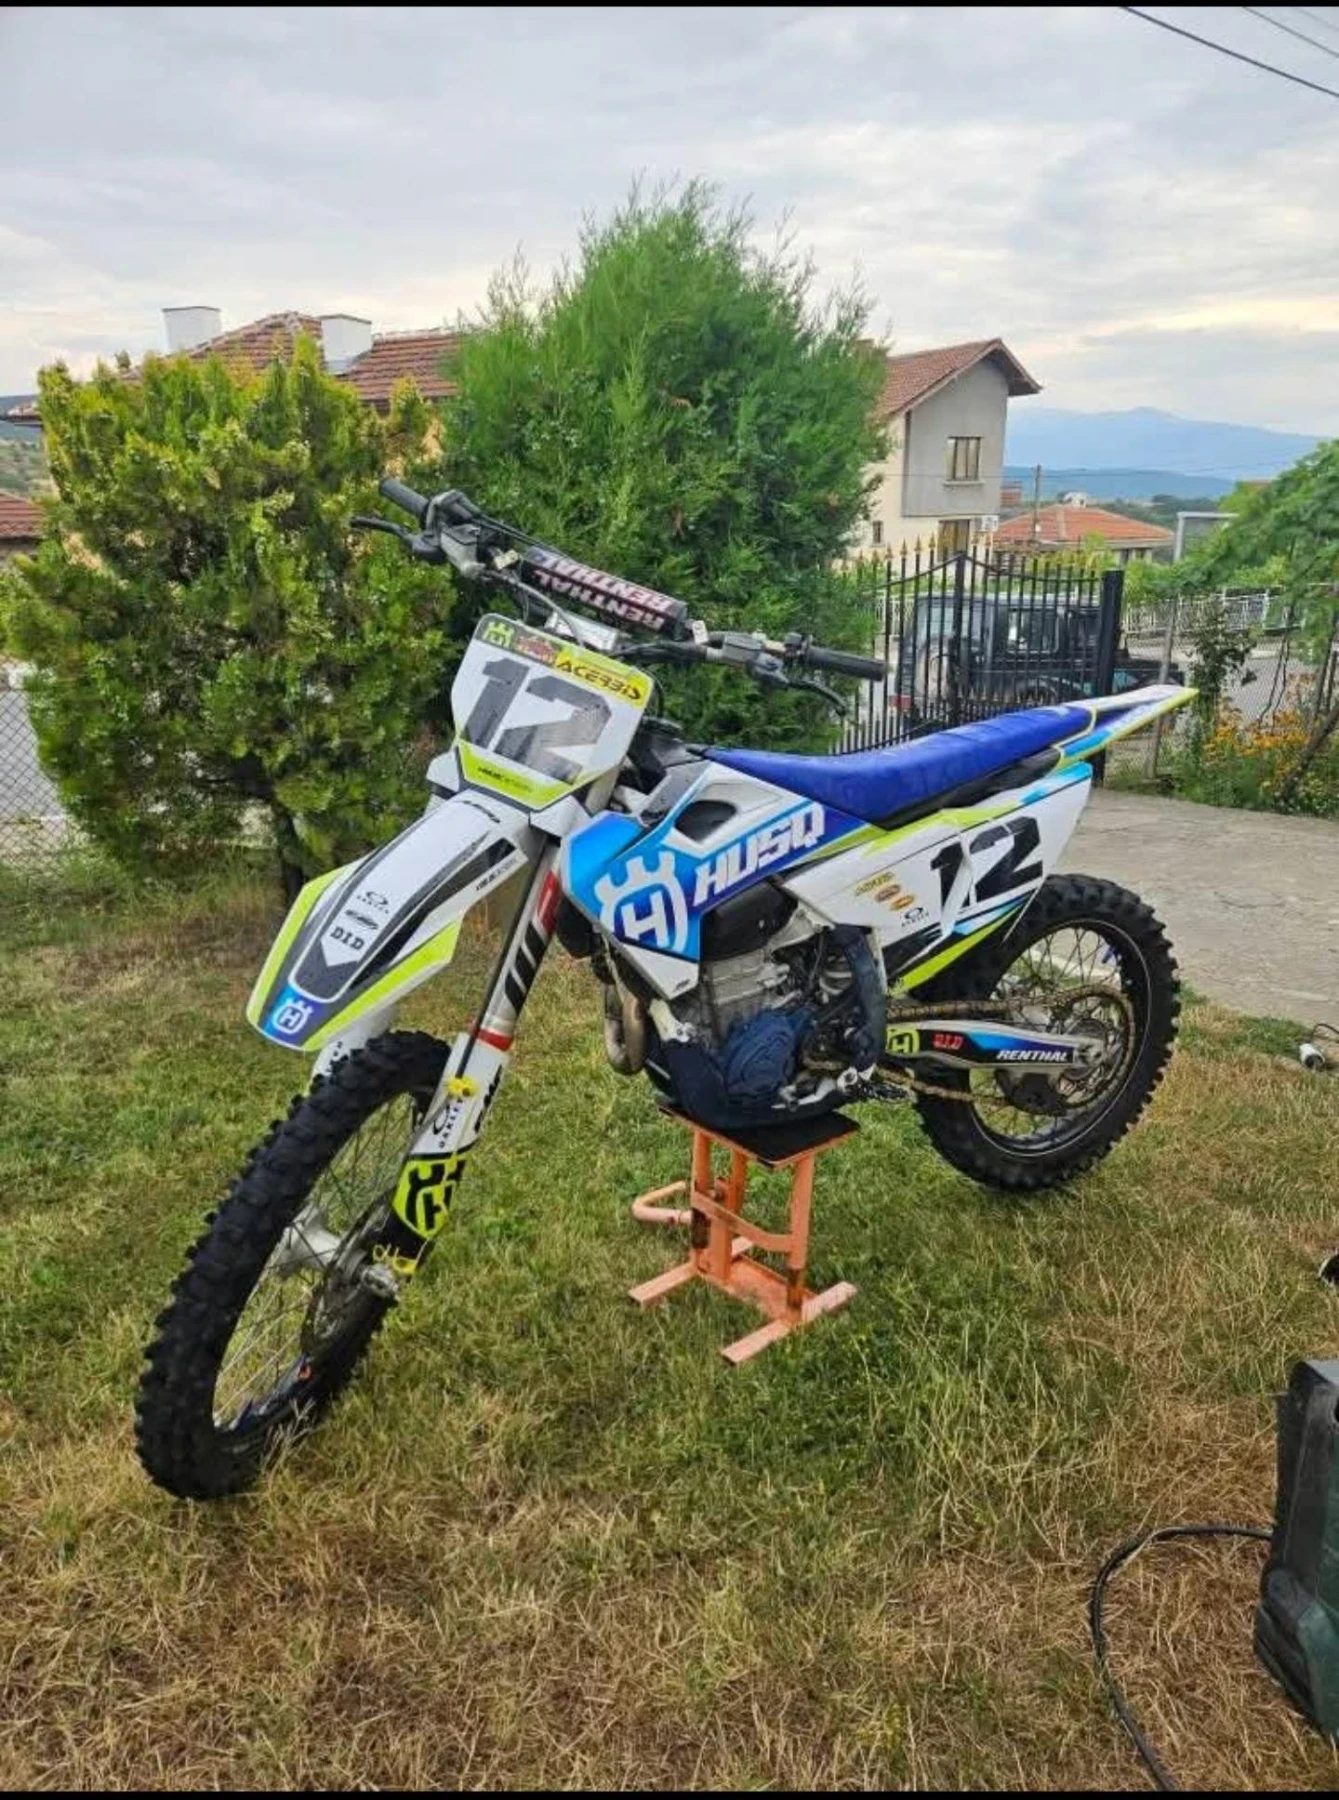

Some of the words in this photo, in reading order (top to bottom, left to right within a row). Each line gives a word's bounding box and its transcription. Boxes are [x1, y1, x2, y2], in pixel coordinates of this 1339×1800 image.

[532, 570, 665, 632] RENTHAL
[556, 661, 642, 701] ACERBIS
[464, 658, 612, 785] 12
[693, 802, 825, 906] HUSQ
[930, 816, 1044, 910] 12
[996, 1049, 1068, 1062] RENTHAL
